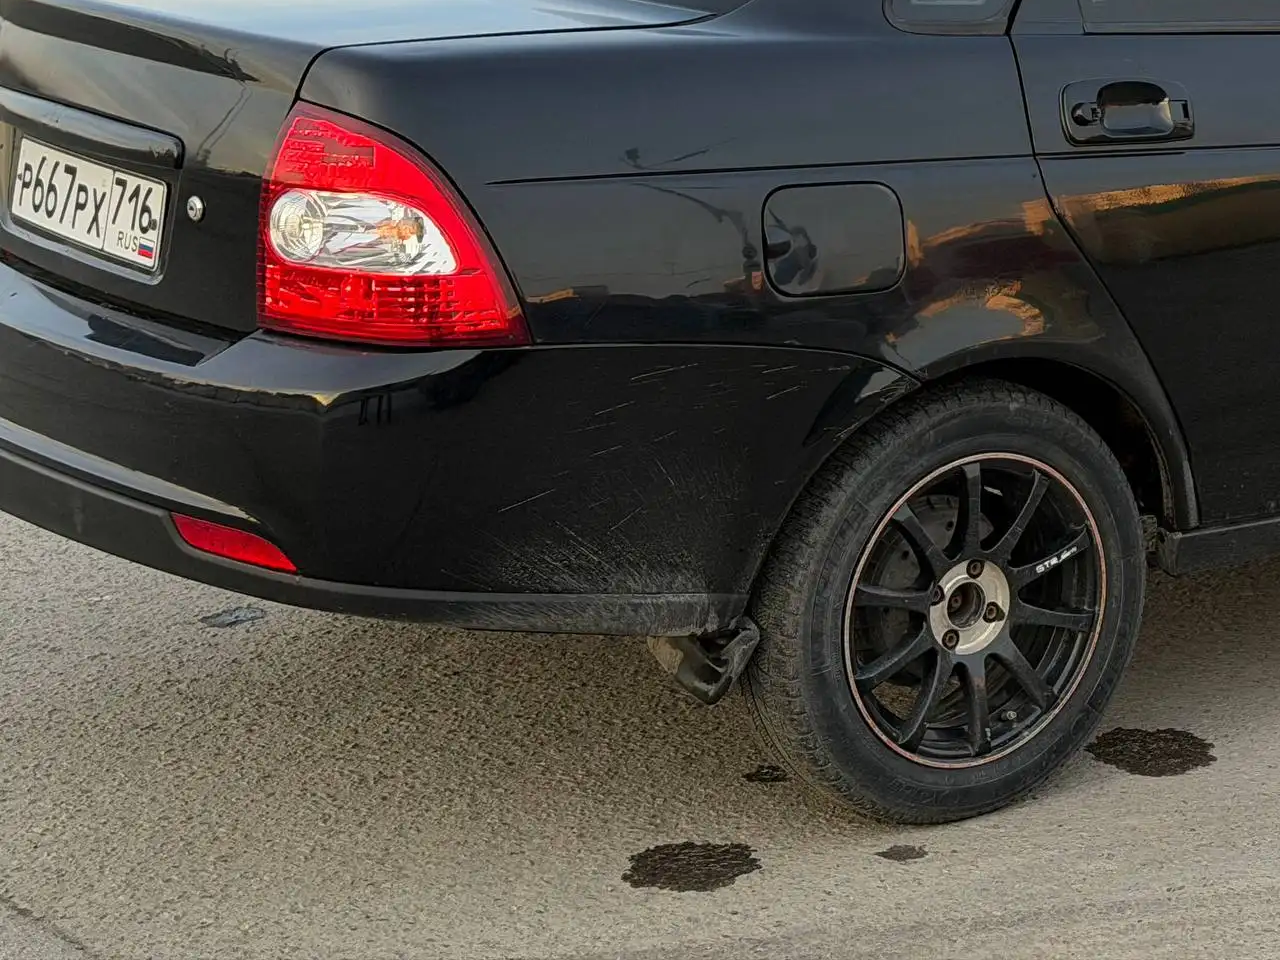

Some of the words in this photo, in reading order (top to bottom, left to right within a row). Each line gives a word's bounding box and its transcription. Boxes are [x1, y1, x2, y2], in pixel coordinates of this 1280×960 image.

[20, 156, 106, 238] Р667РХ
[111, 177, 154, 234] 716
[116, 230, 138, 252] RUS
